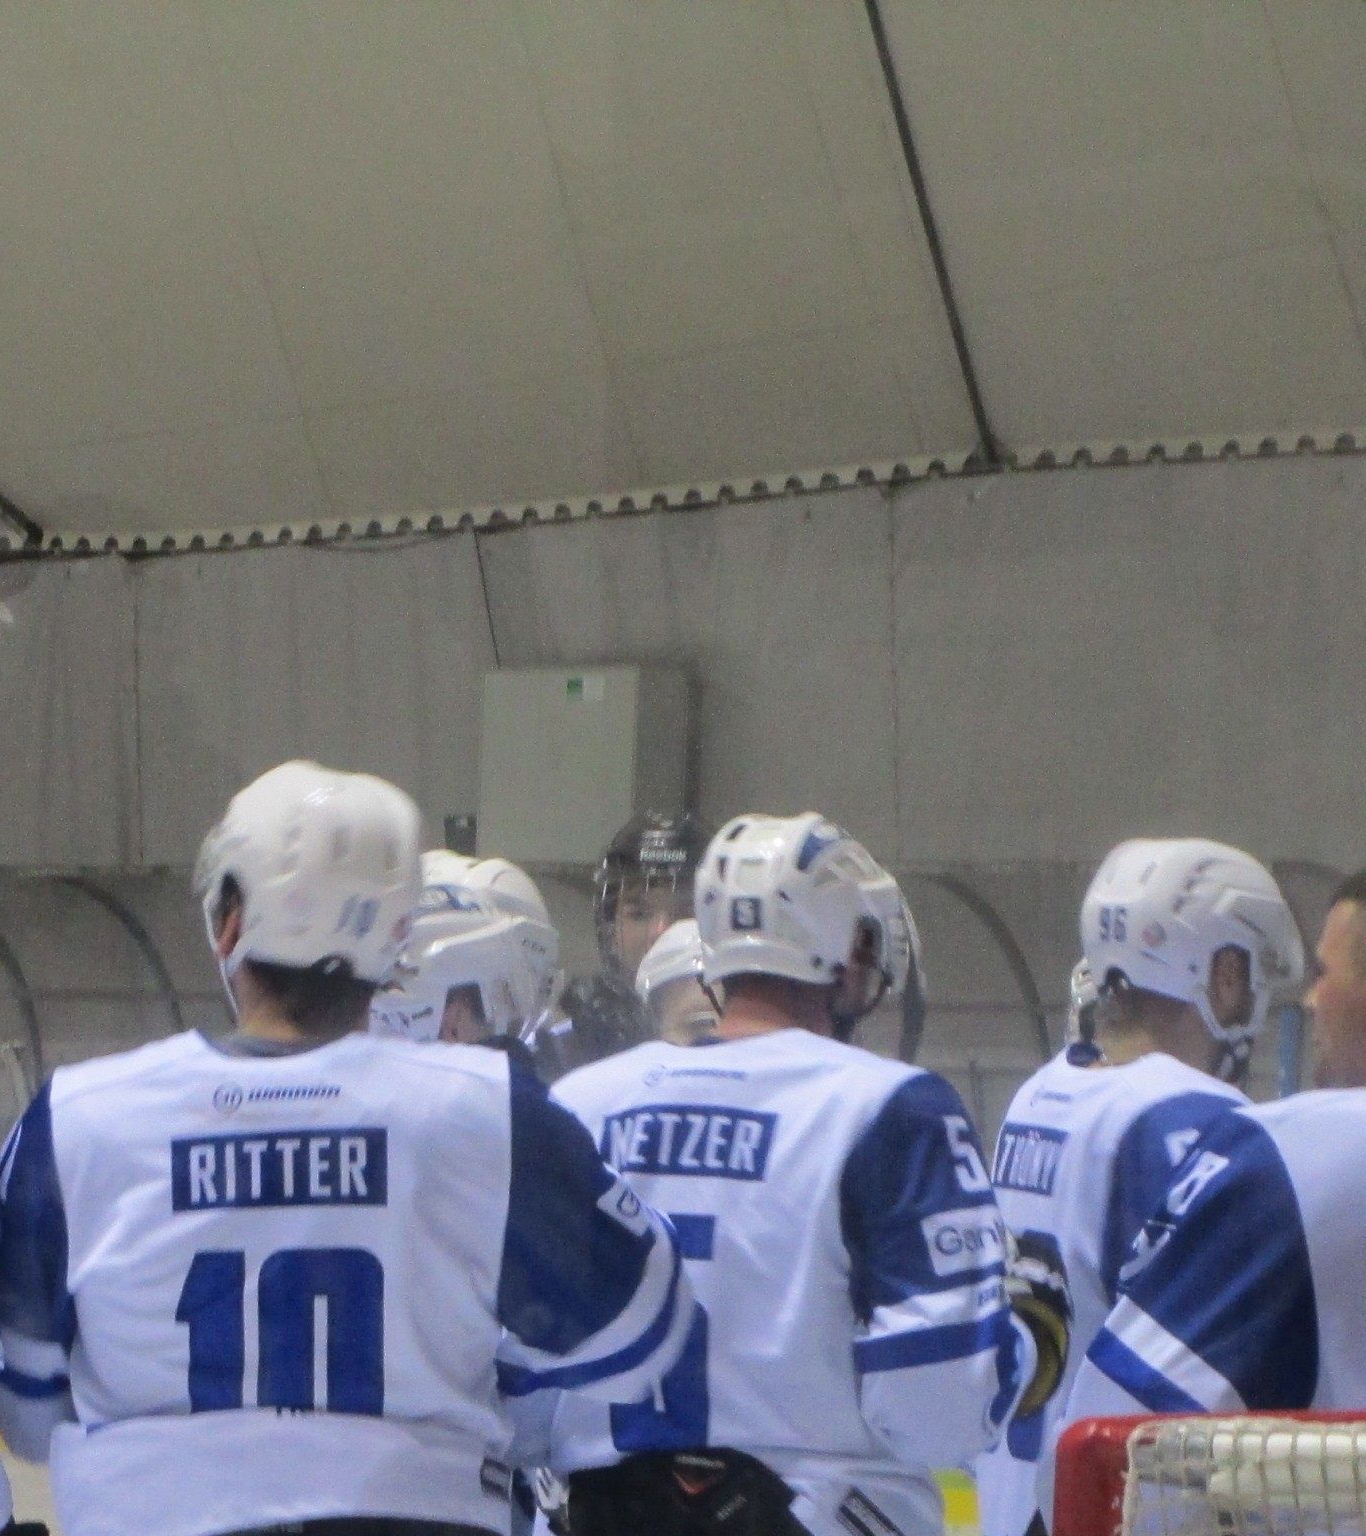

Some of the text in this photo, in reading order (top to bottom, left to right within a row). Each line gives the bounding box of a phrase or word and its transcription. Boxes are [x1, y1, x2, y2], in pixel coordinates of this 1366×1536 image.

[189, 1136, 368, 1204] RITTER
[610, 1112, 763, 1173] NETZER
[175, 1248, 385, 1414] 10
